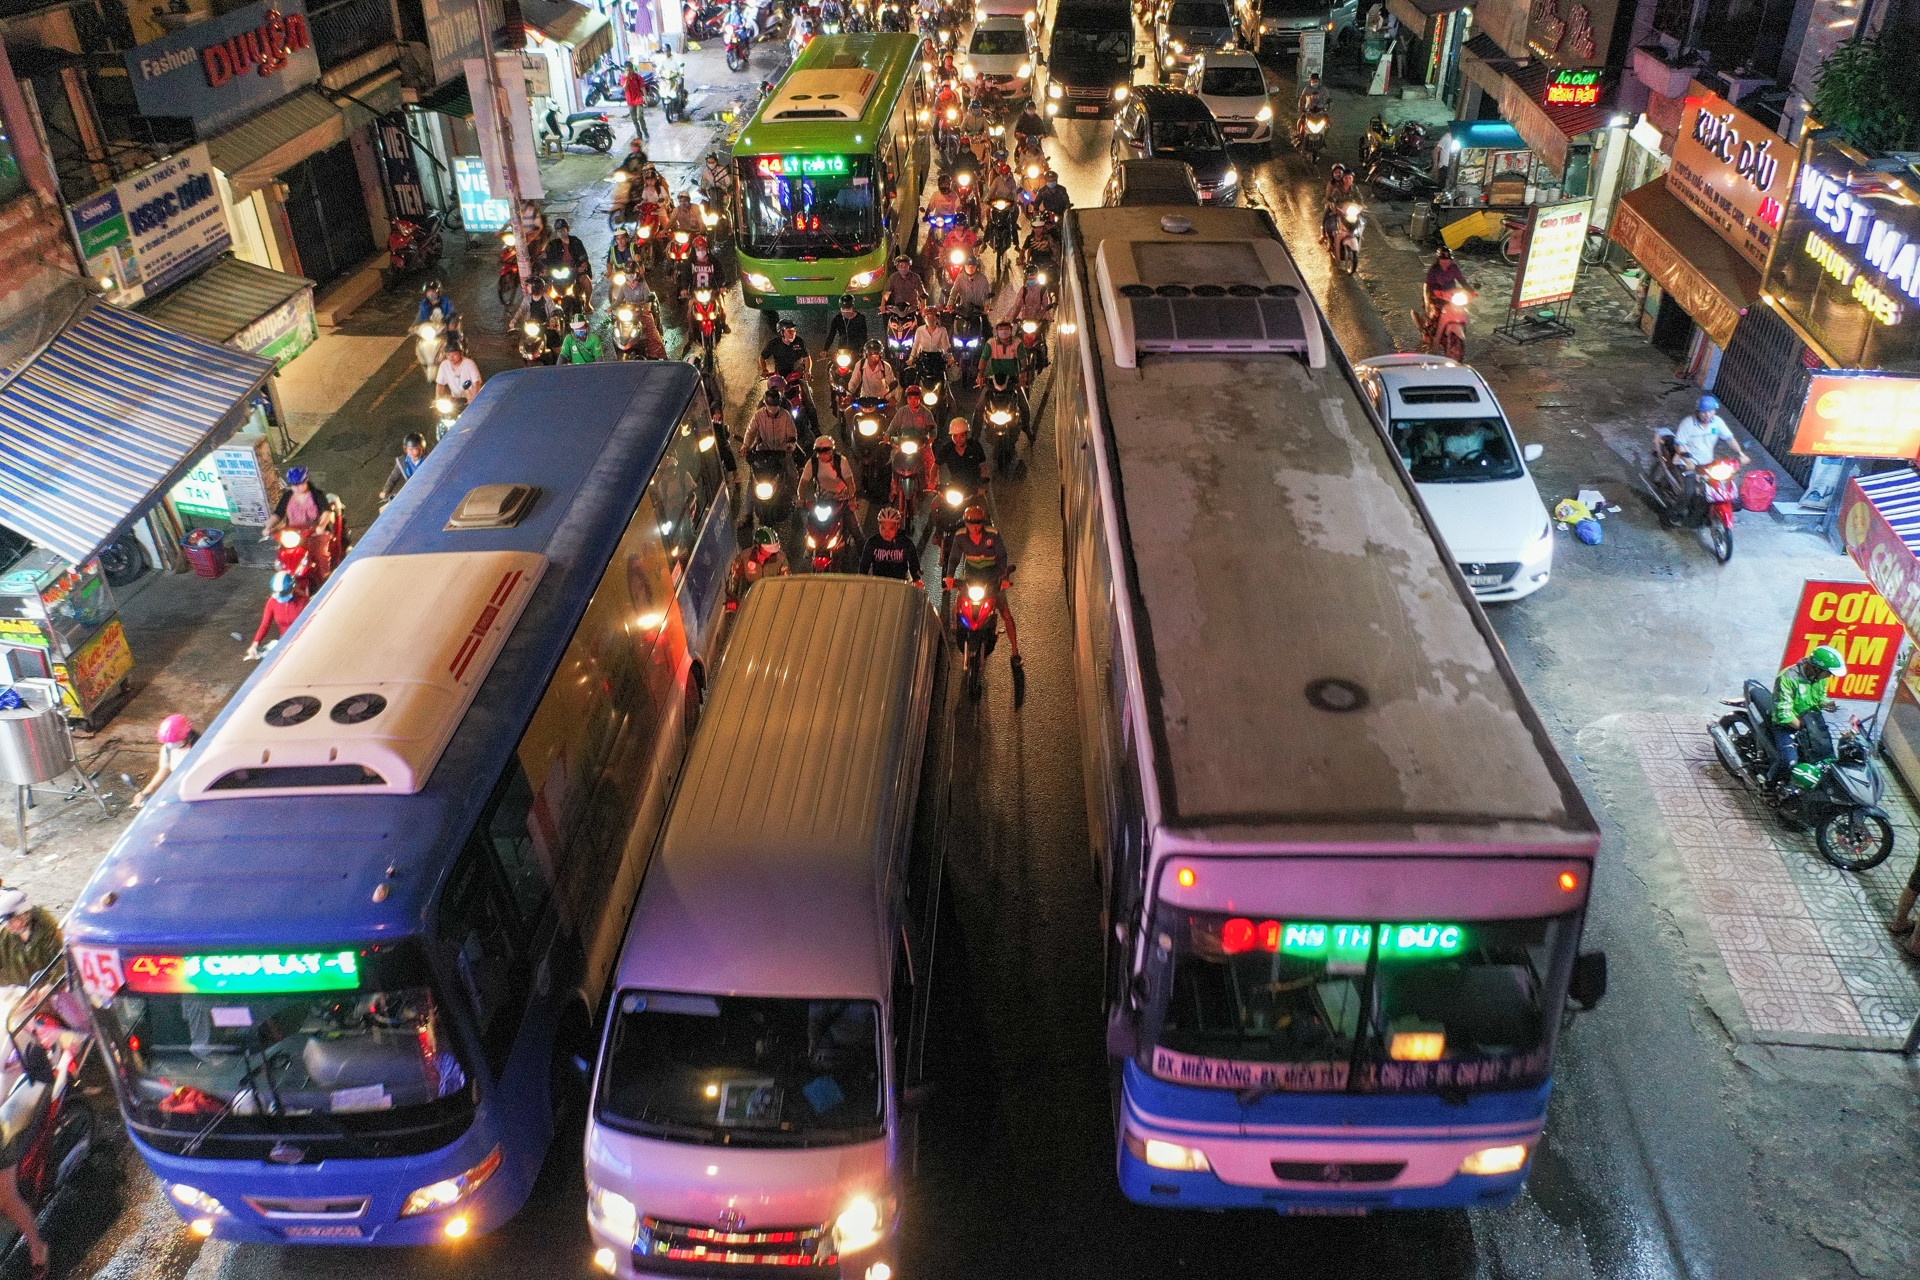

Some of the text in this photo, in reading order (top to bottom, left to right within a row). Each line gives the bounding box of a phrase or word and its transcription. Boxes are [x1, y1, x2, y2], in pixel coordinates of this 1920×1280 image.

[140, 46, 198, 82] Fashion
[1691, 107, 1780, 193] KHẮC DẤU
[457, 169, 491, 196] VIỆ
[1799, 163, 1875, 245] WEST
[1804, 230, 1857, 287] LUXURY
[1851, 274, 1903, 327] SHOES
[1808, 590, 1900, 626] CƠM
[1803, 624, 1889, 667] TẤM
[1841, 673, 1880, 697] QUE
[82, 953, 118, 992] 45
